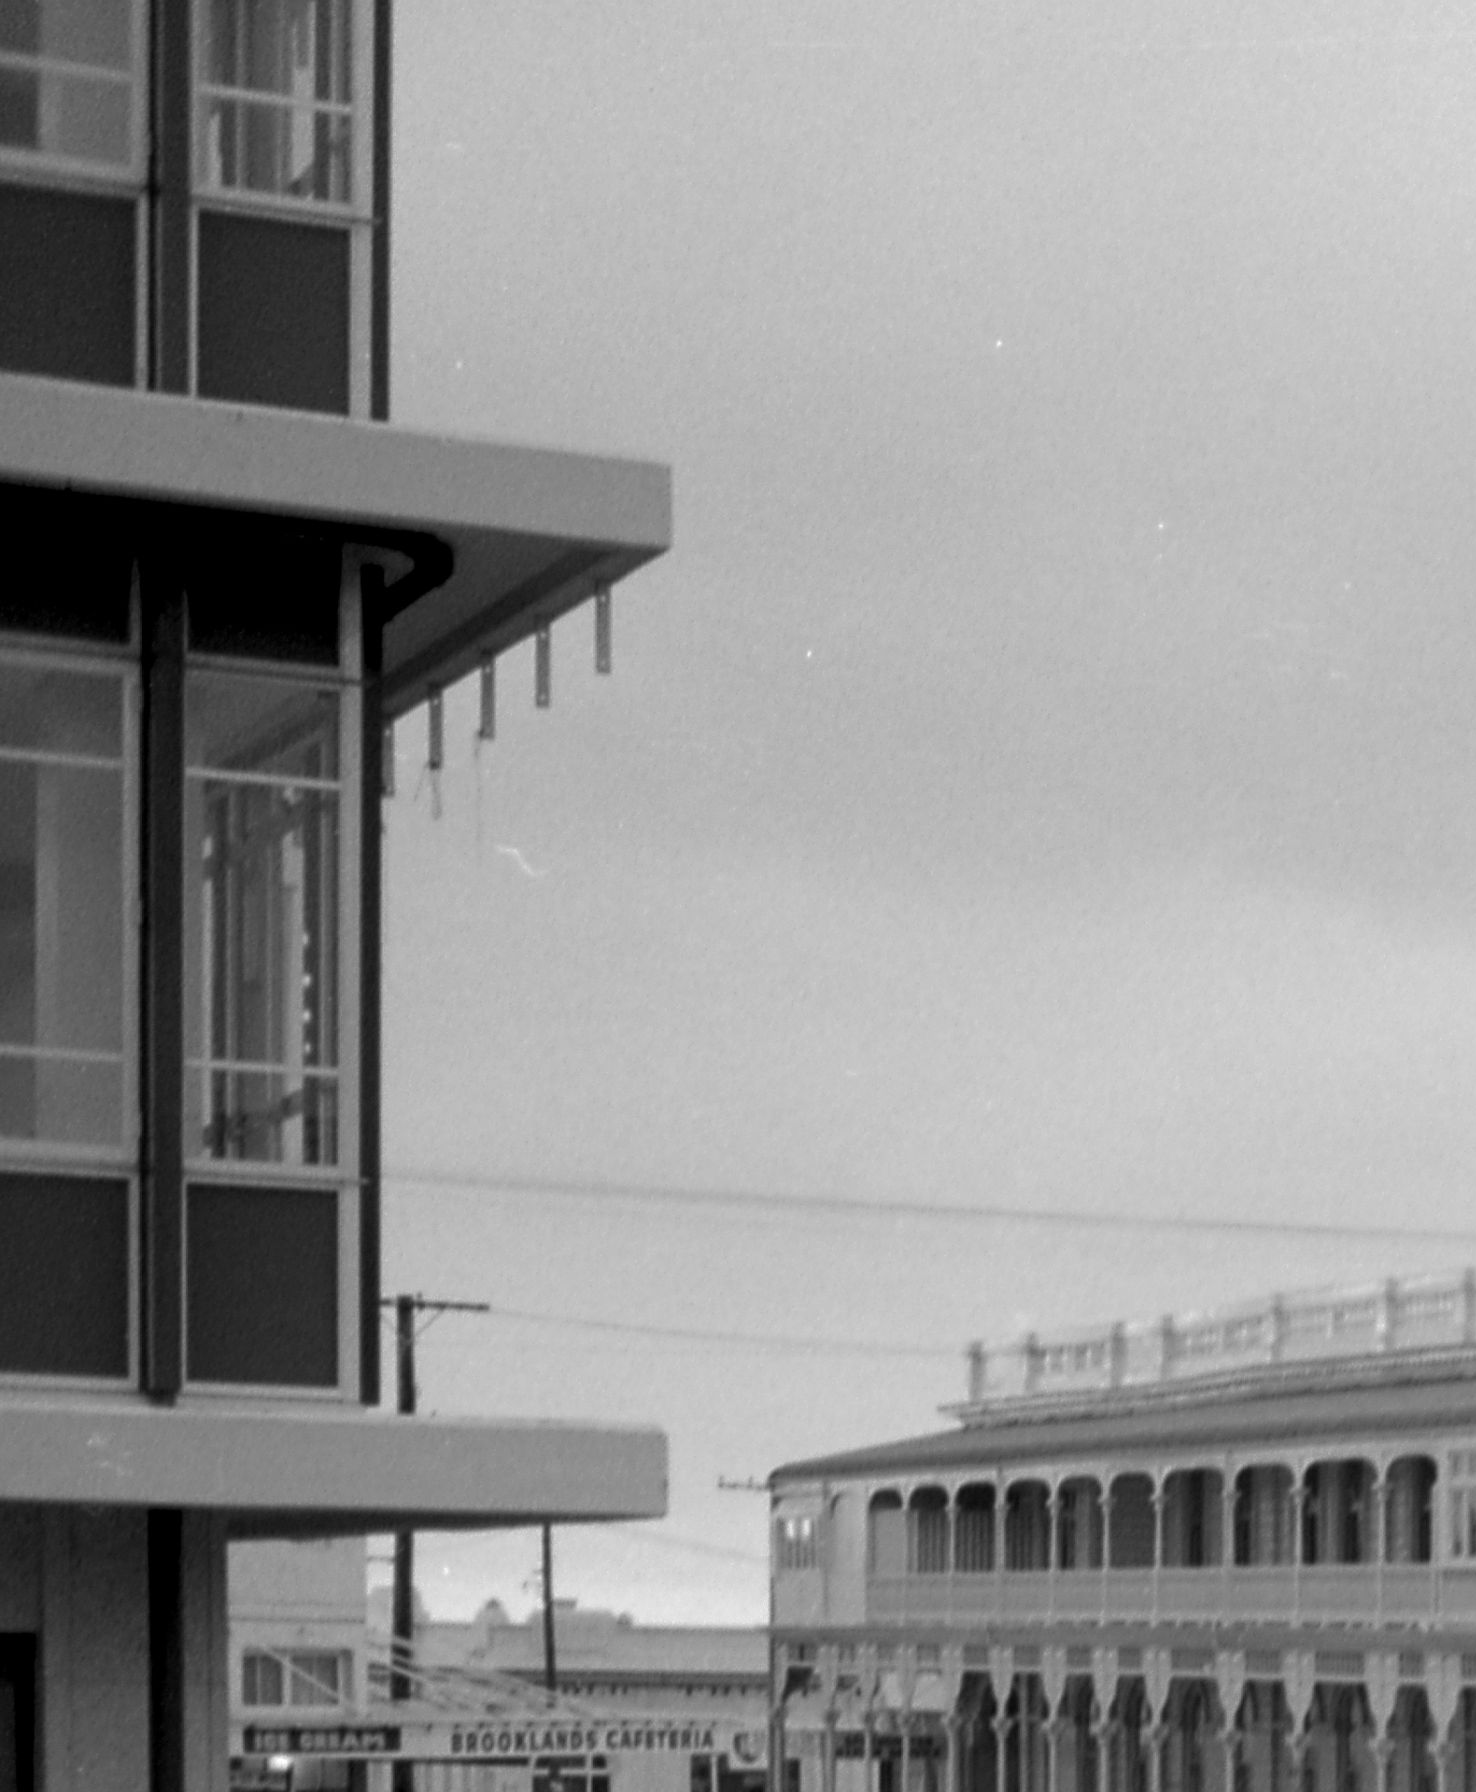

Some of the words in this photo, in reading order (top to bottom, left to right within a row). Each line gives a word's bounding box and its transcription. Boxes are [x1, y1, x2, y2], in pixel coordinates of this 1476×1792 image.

[252, 1728, 296, 1752] ICE
[300, 1728, 388, 1752] CREAM
[449, 1726, 599, 1754] BROOKLANDS
[605, 1724, 715, 1753] CAFETERIA
